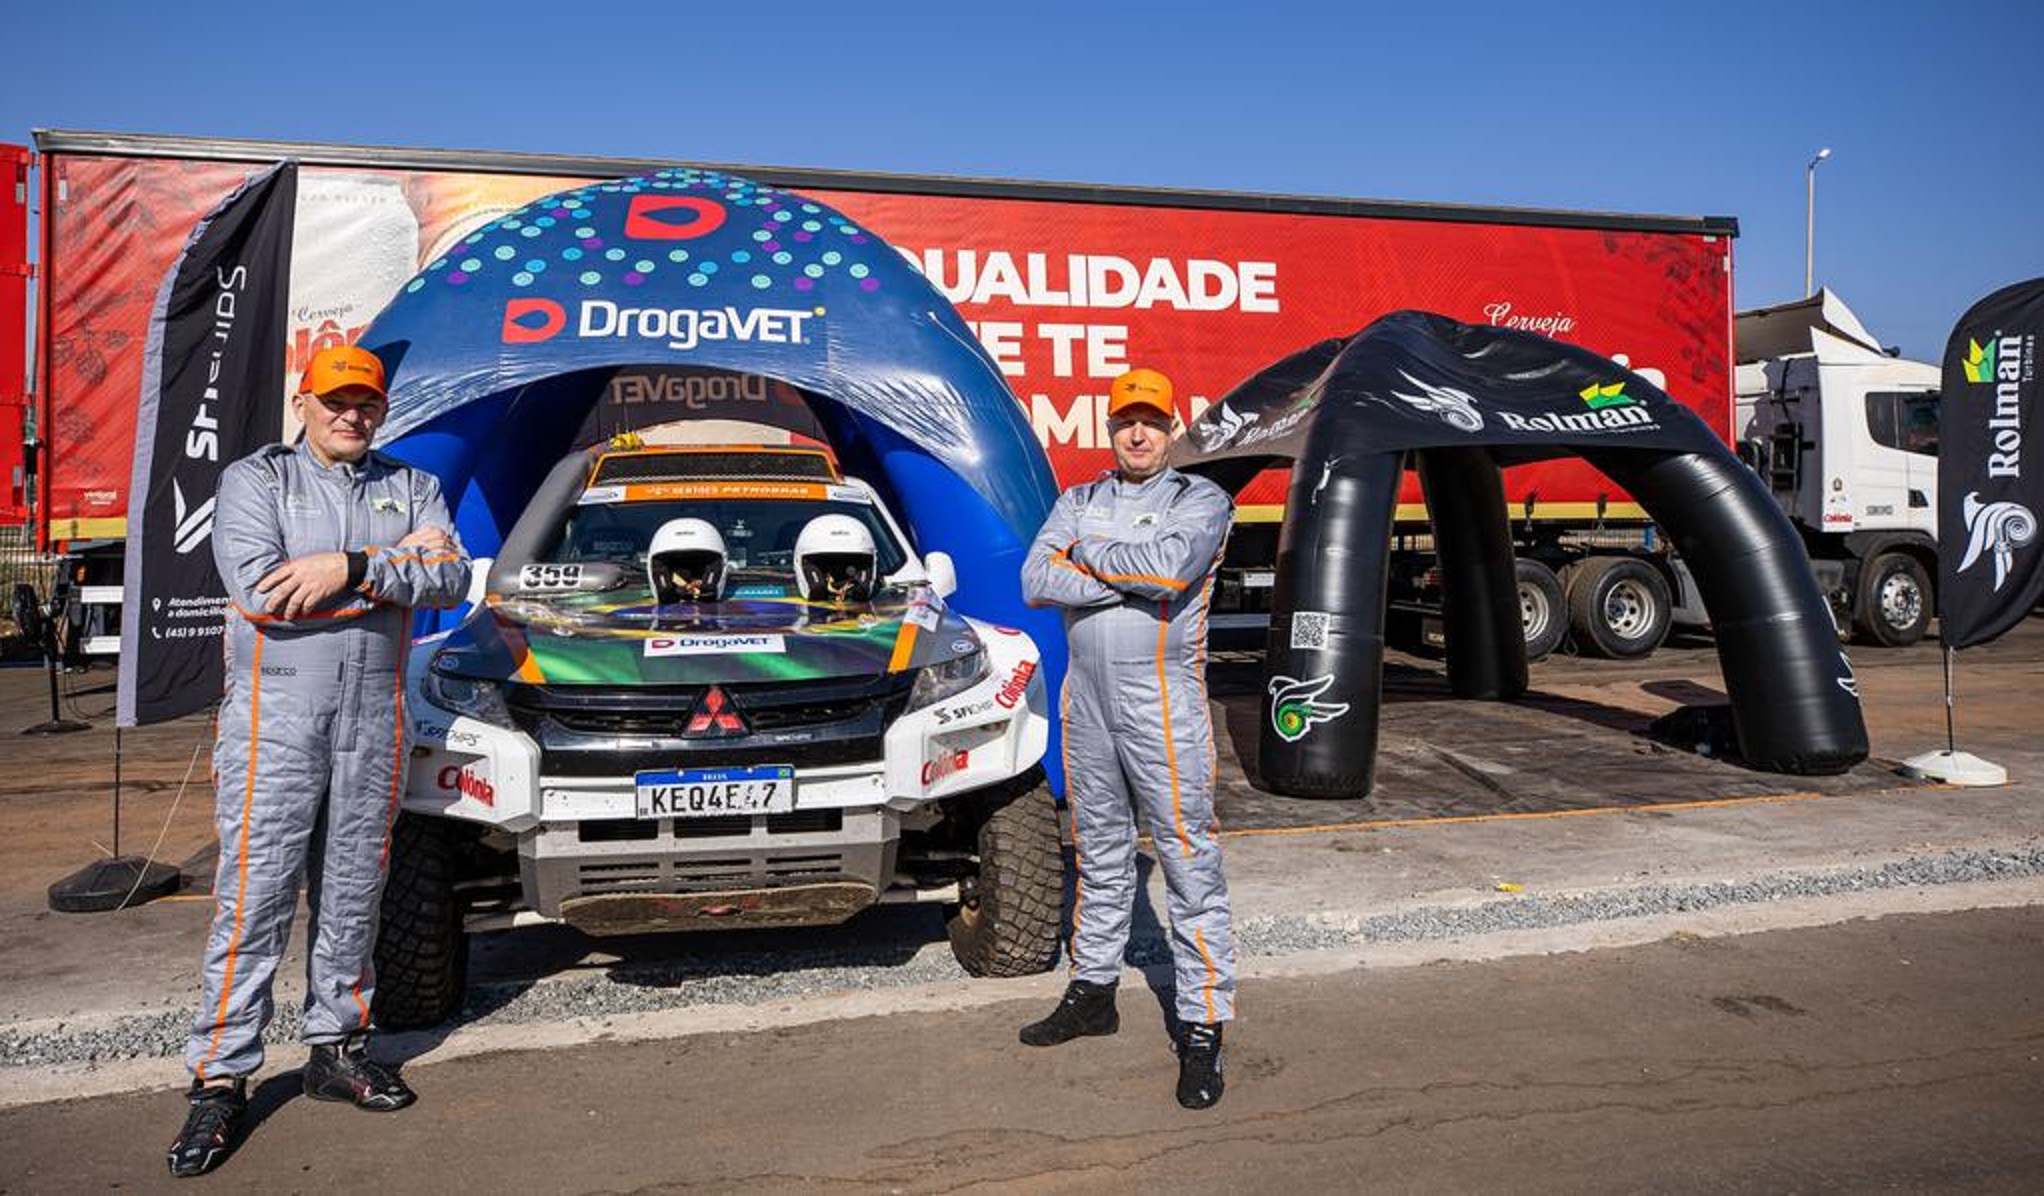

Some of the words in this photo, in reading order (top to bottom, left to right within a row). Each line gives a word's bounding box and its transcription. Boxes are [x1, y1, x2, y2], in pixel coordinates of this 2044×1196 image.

[578, 300, 813, 350] DrogaVET
[1484, 302, 1575, 338] Cerveja
[1037, 323, 1131, 379] TE
[1496, 403, 1653, 432] Rolman
[1988, 335, 2022, 479] Rolman
[523, 565, 580, 588] 359
[165, 627, 187, 638] (45)
[680, 636, 769, 649] DrogaVET
[437, 765, 494, 807] Colônia
